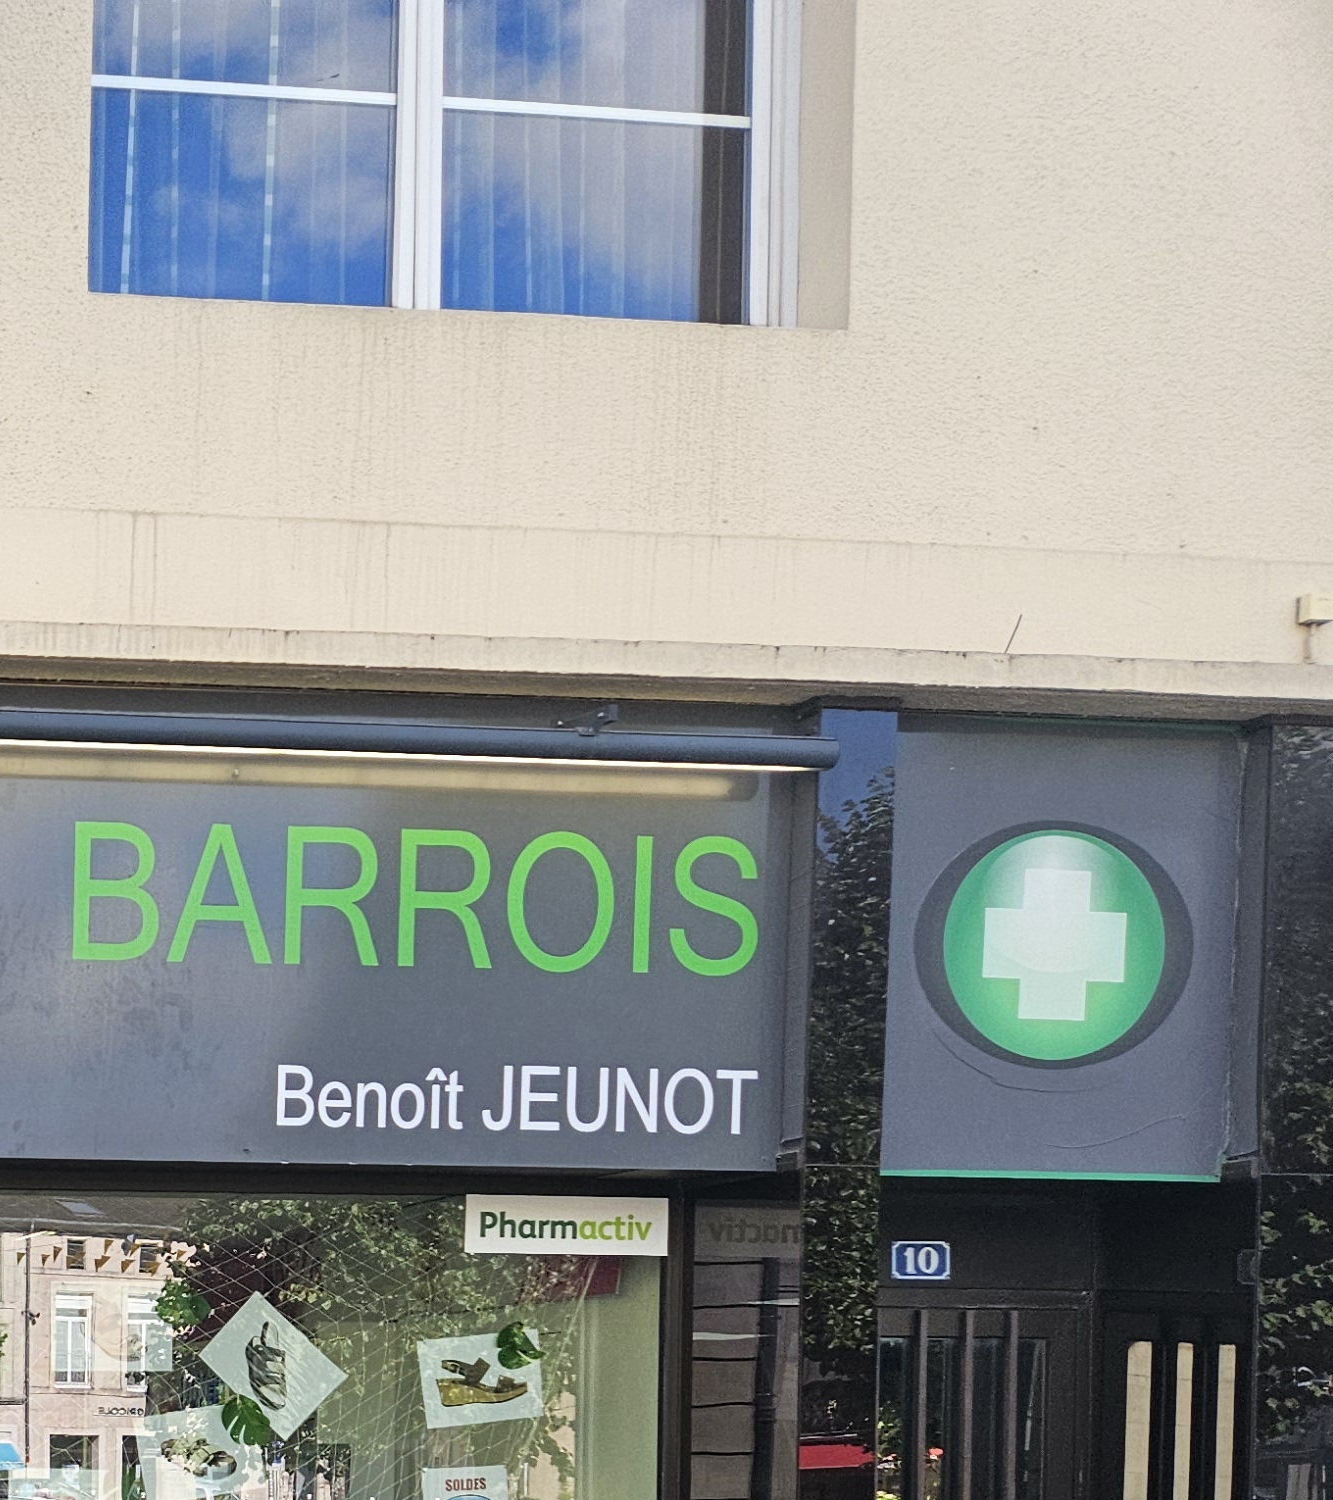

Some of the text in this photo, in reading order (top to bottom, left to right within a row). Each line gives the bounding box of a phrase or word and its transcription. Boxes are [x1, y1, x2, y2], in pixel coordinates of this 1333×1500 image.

[72, 821, 759, 976] BARROIS
[275, 1065, 758, 1136] Benoît JEUNOT
[480, 1211, 652, 1241] Pharmactiv
[903, 1246, 940, 1275] 10
[445, 1478, 486, 1491] SOLDES
